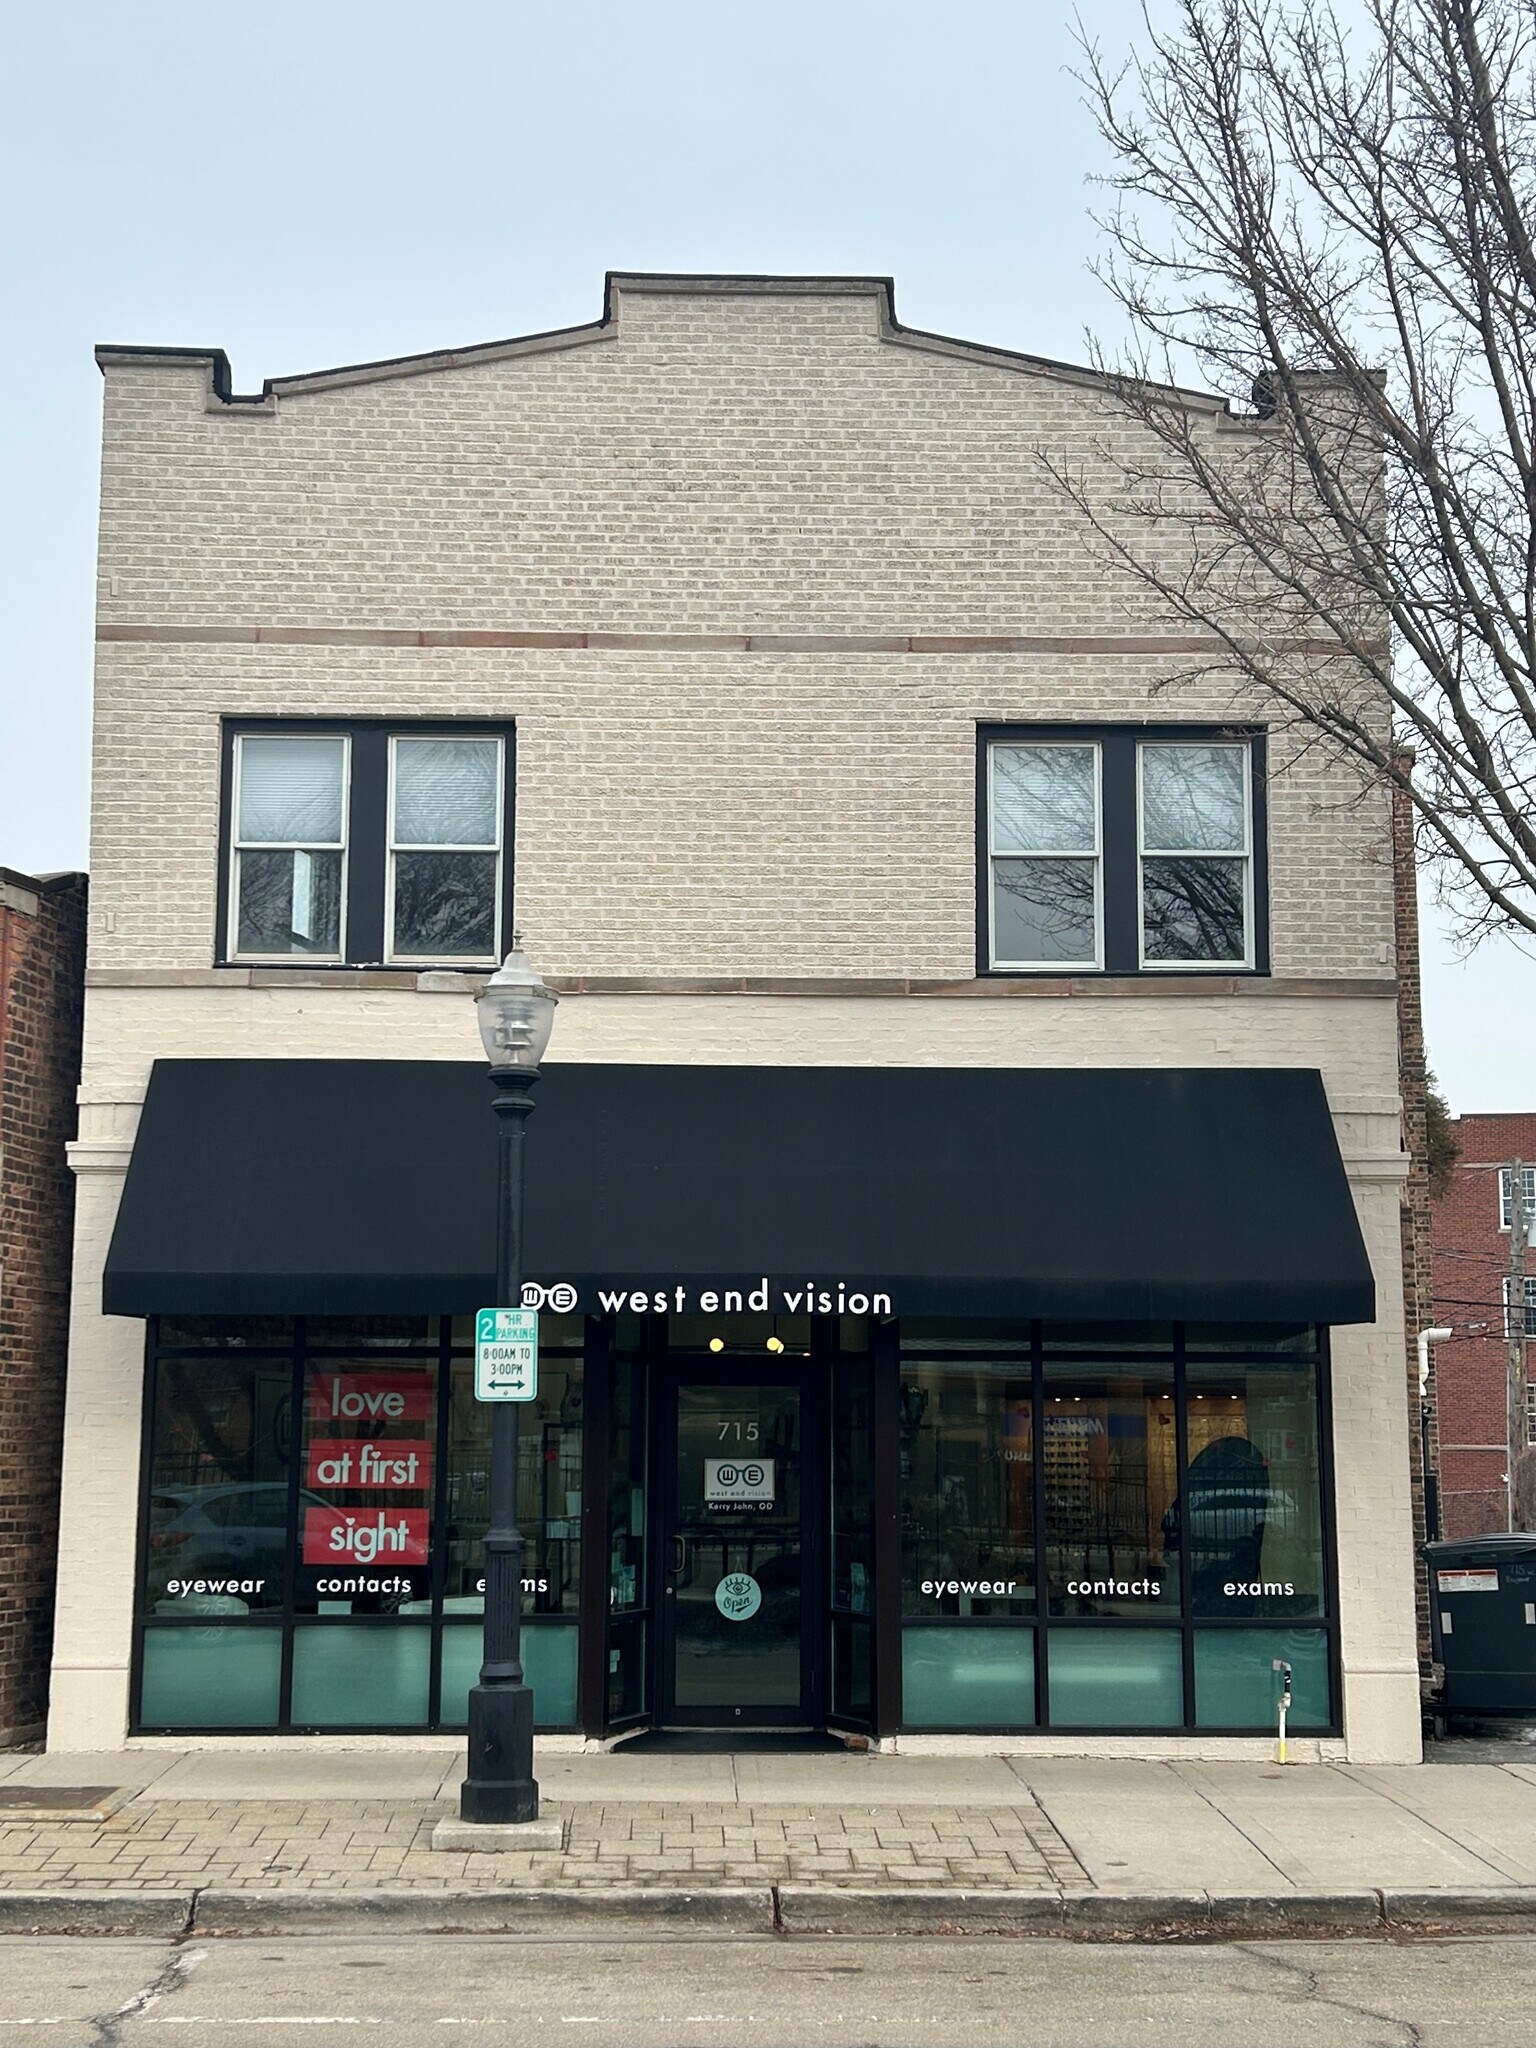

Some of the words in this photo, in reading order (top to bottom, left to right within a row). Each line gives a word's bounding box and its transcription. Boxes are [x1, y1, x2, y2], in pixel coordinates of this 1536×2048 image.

[597, 1286, 686, 1313] west
[700, 1277, 768, 1313] end
[783, 1282, 891, 1314] vision
[481, 1317, 494, 1340] 2
[508, 1314, 522, 1325] HR
[497, 1328, 535, 1339] PARKING
[483, 1347, 516, 1360] 8:00AM
[520, 1347, 531, 1360] TO
[491, 1363, 523, 1375] 3:00PM
[332, 1378, 405, 1417] love
[718, 1422, 759, 1441] 715
[317, 1453, 353, 1484] at
[359, 1445, 419, 1484] first
[730, 1489, 745, 1497] end
[758, 1502, 773, 1511] OD
[329, 1512, 410, 1563] sight
[167, 1578, 265, 1598] eyewear
[316, 1575, 412, 1593] contacts
[476, 1578, 548, 1592] ems
[920, 1579, 1017, 1599] eyewear
[1067, 1577, 1161, 1596] contacts
[1223, 1582, 1295, 1597] exams
[723, 1597, 750, 1614] Open
